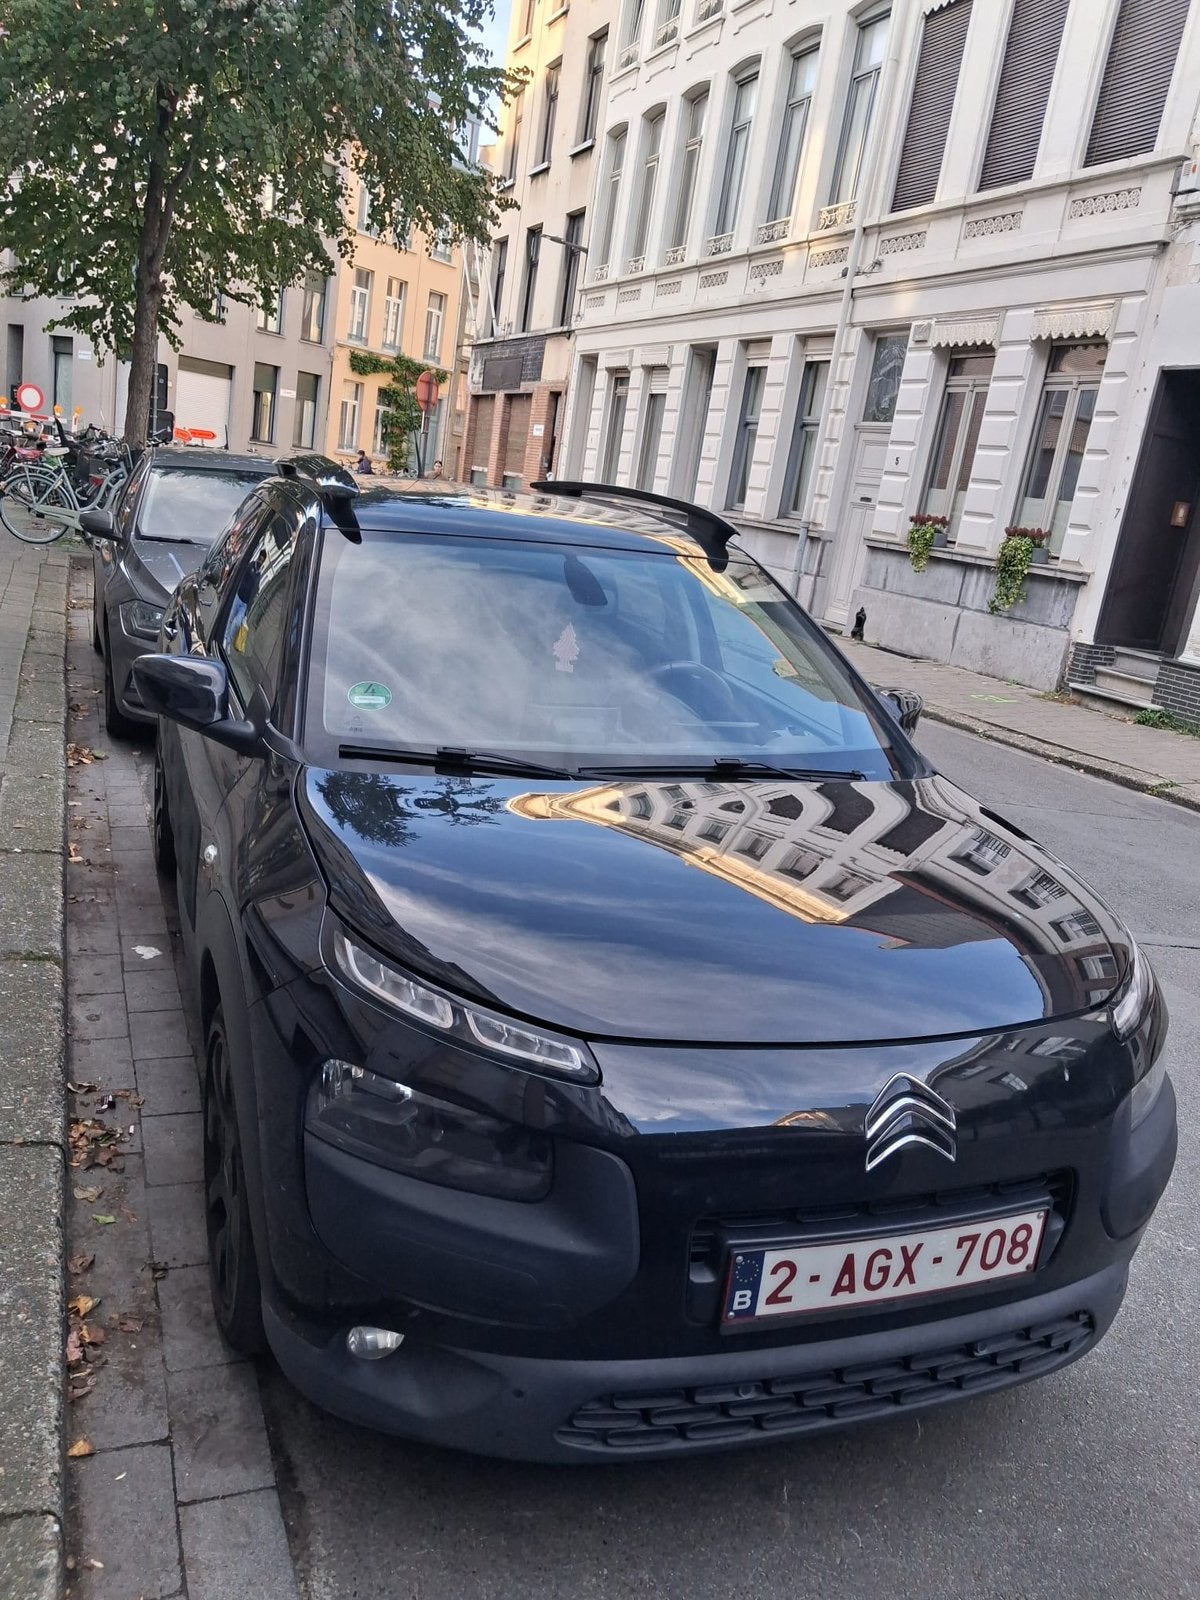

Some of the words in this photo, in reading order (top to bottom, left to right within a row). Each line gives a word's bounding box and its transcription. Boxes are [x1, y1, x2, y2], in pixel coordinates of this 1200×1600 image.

[895, 456, 900, 466] 5
[1114, 508, 1121, 519] 7
[732, 1289, 752, 1311] B
